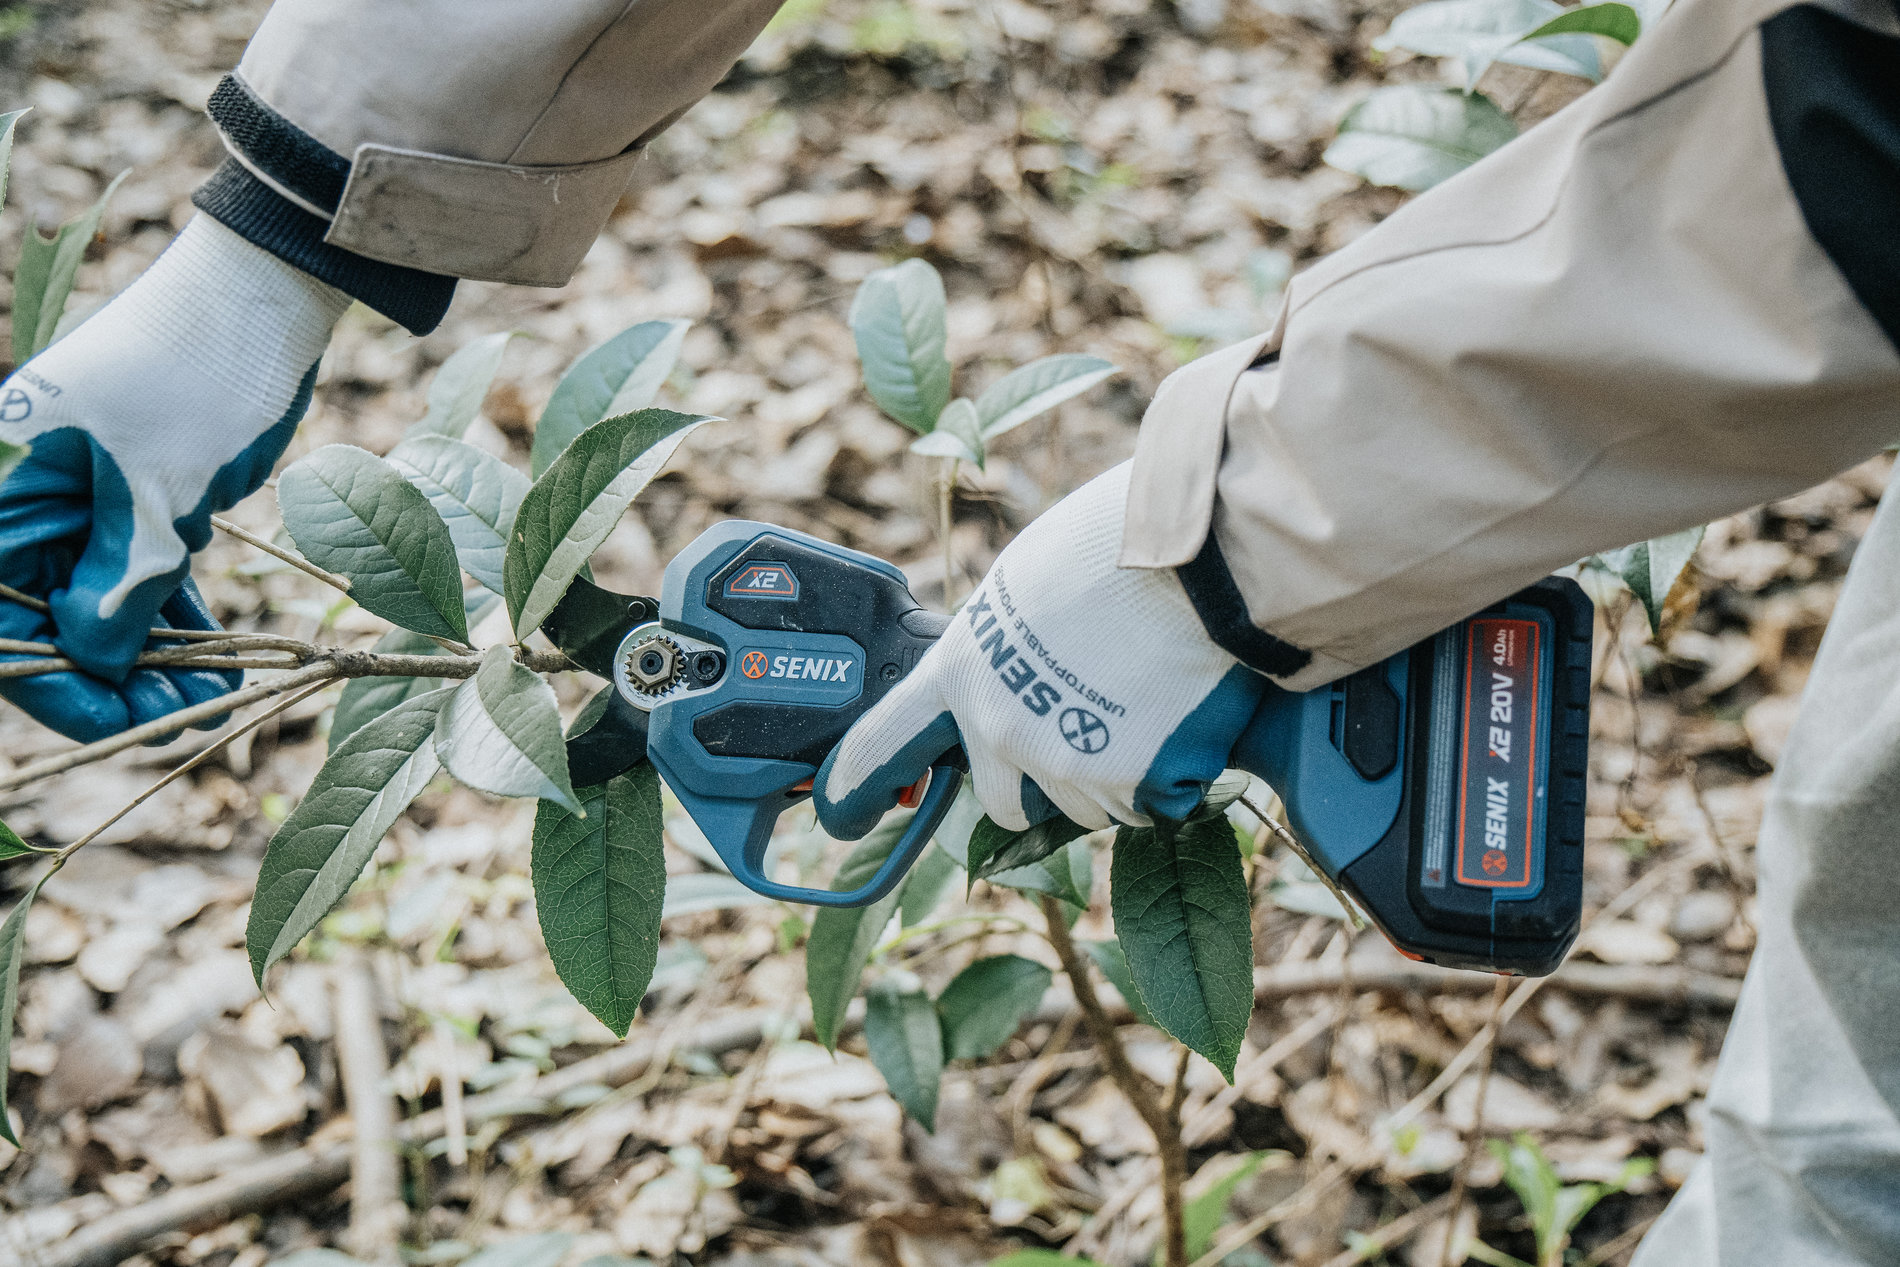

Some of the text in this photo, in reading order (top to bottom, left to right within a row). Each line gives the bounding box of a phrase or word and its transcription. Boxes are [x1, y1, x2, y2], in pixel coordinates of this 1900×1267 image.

[747, 572, 778, 588] X2
[769, 656, 854, 682] SENIX
[966, 591, 1062, 717] SENIX
[1014, 616, 1126, 717] UNSTOPPABLE
[1486, 629, 1515, 851] SENIX X2 20V 4.0Ah
